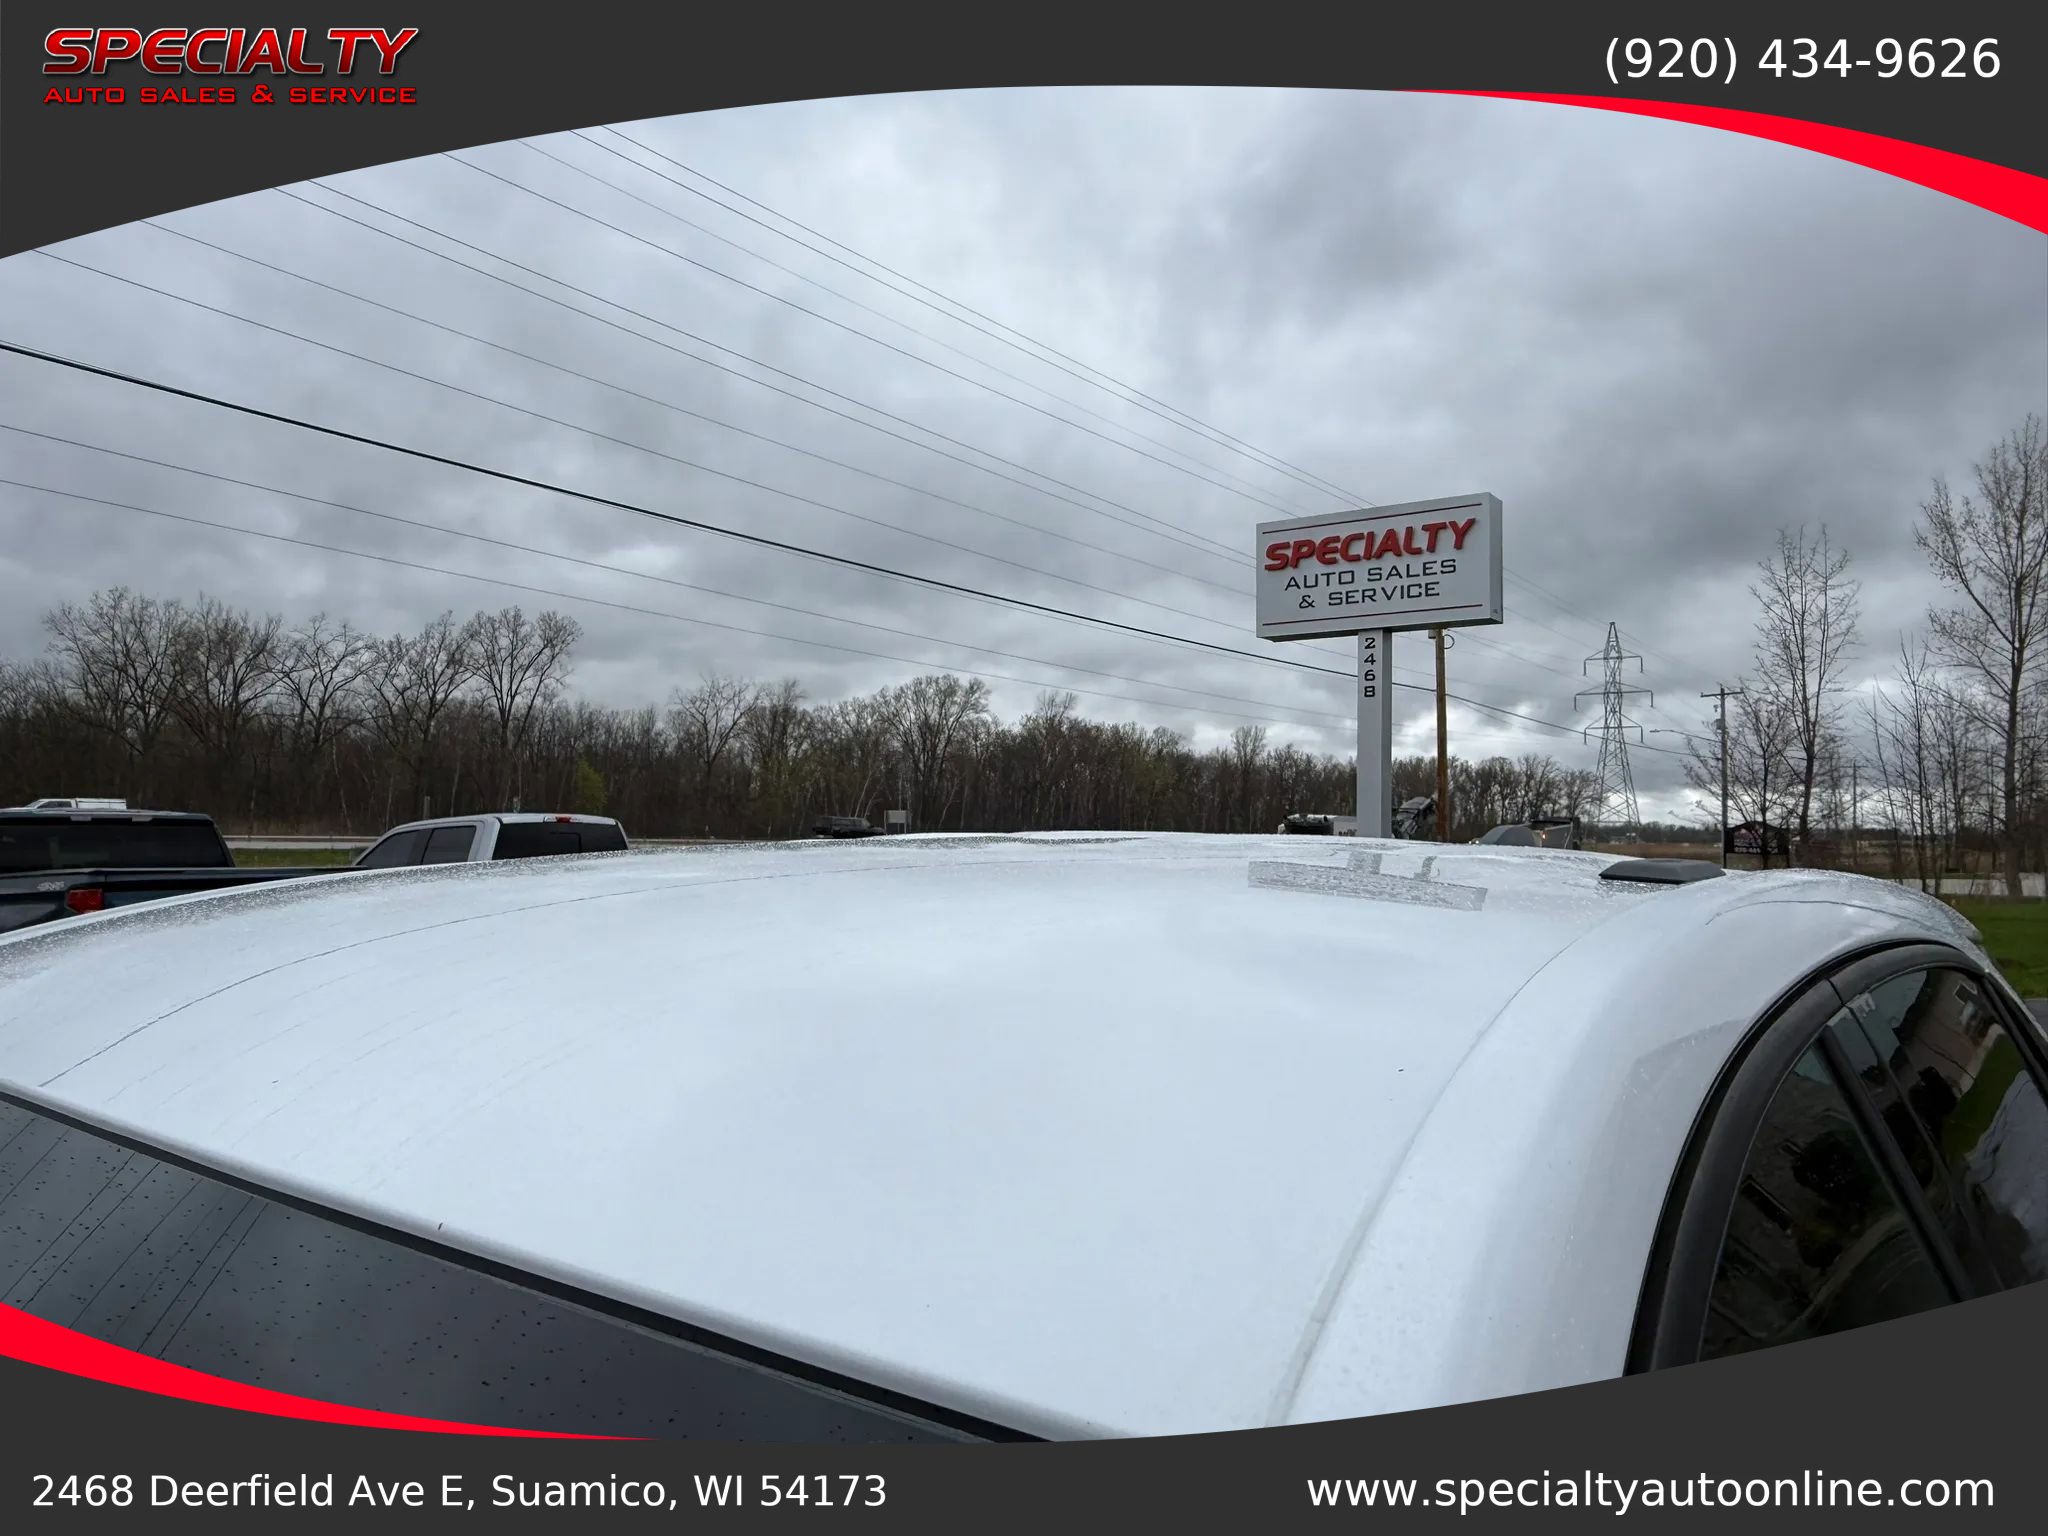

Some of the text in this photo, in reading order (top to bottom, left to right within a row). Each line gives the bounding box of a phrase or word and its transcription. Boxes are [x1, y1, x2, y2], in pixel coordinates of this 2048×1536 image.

[1264, 518, 1476, 571] SPECIALTY
[1284, 558, 1457, 591] AUTO SALES
[1298, 581, 1440, 609] & SERVICE
[1363, 637, 1377, 698] 2468
